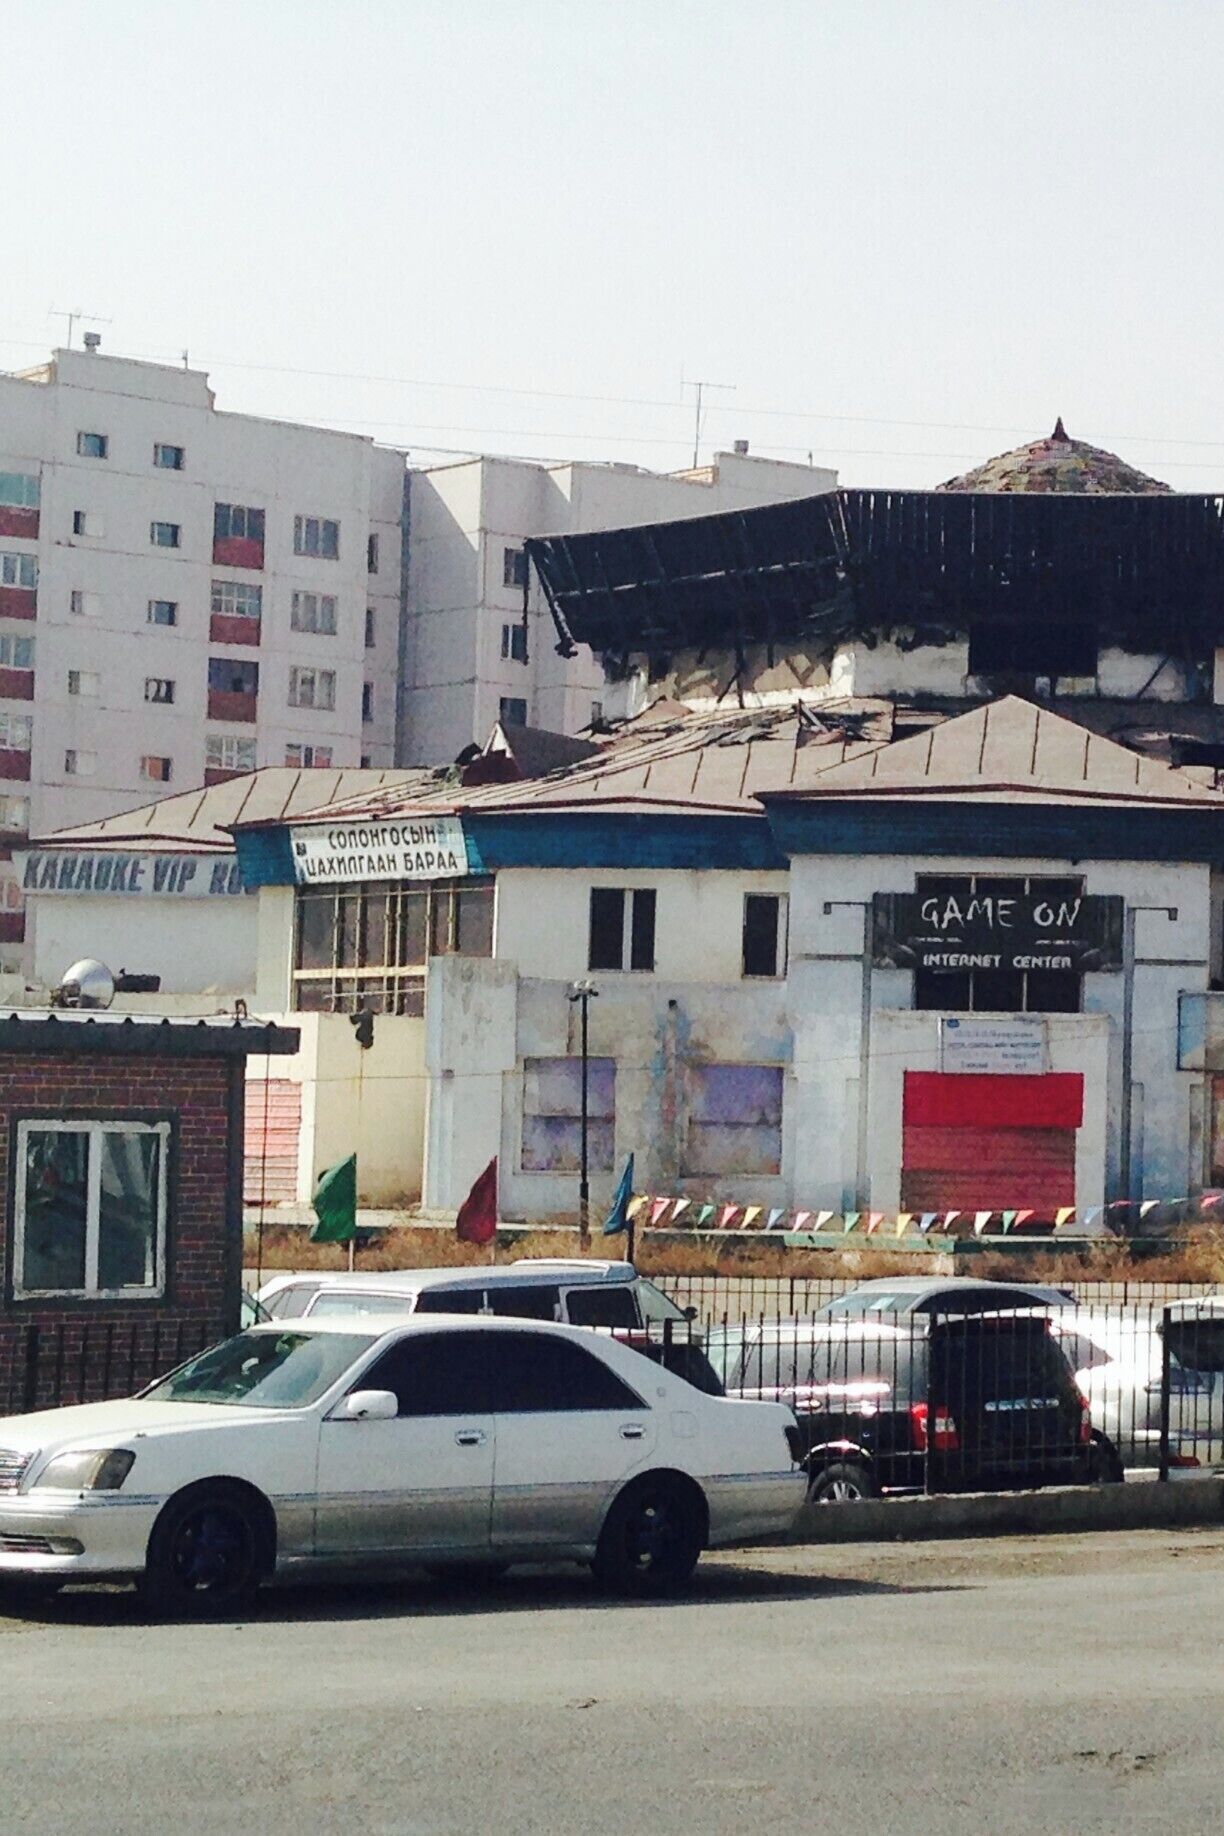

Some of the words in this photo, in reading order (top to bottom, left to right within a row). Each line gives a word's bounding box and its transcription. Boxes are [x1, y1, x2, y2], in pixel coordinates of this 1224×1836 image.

[23, 855, 147, 892] KARAOKE
[152, 857, 197, 893] VIP
[403, 851, 458, 872] БАРАА
[921, 896, 1018, 929] GAME
[1033, 898, 1082, 928] ON
[923, 953, 1002, 968] INTERNET
[1012, 955, 1073, 969] CENTER
